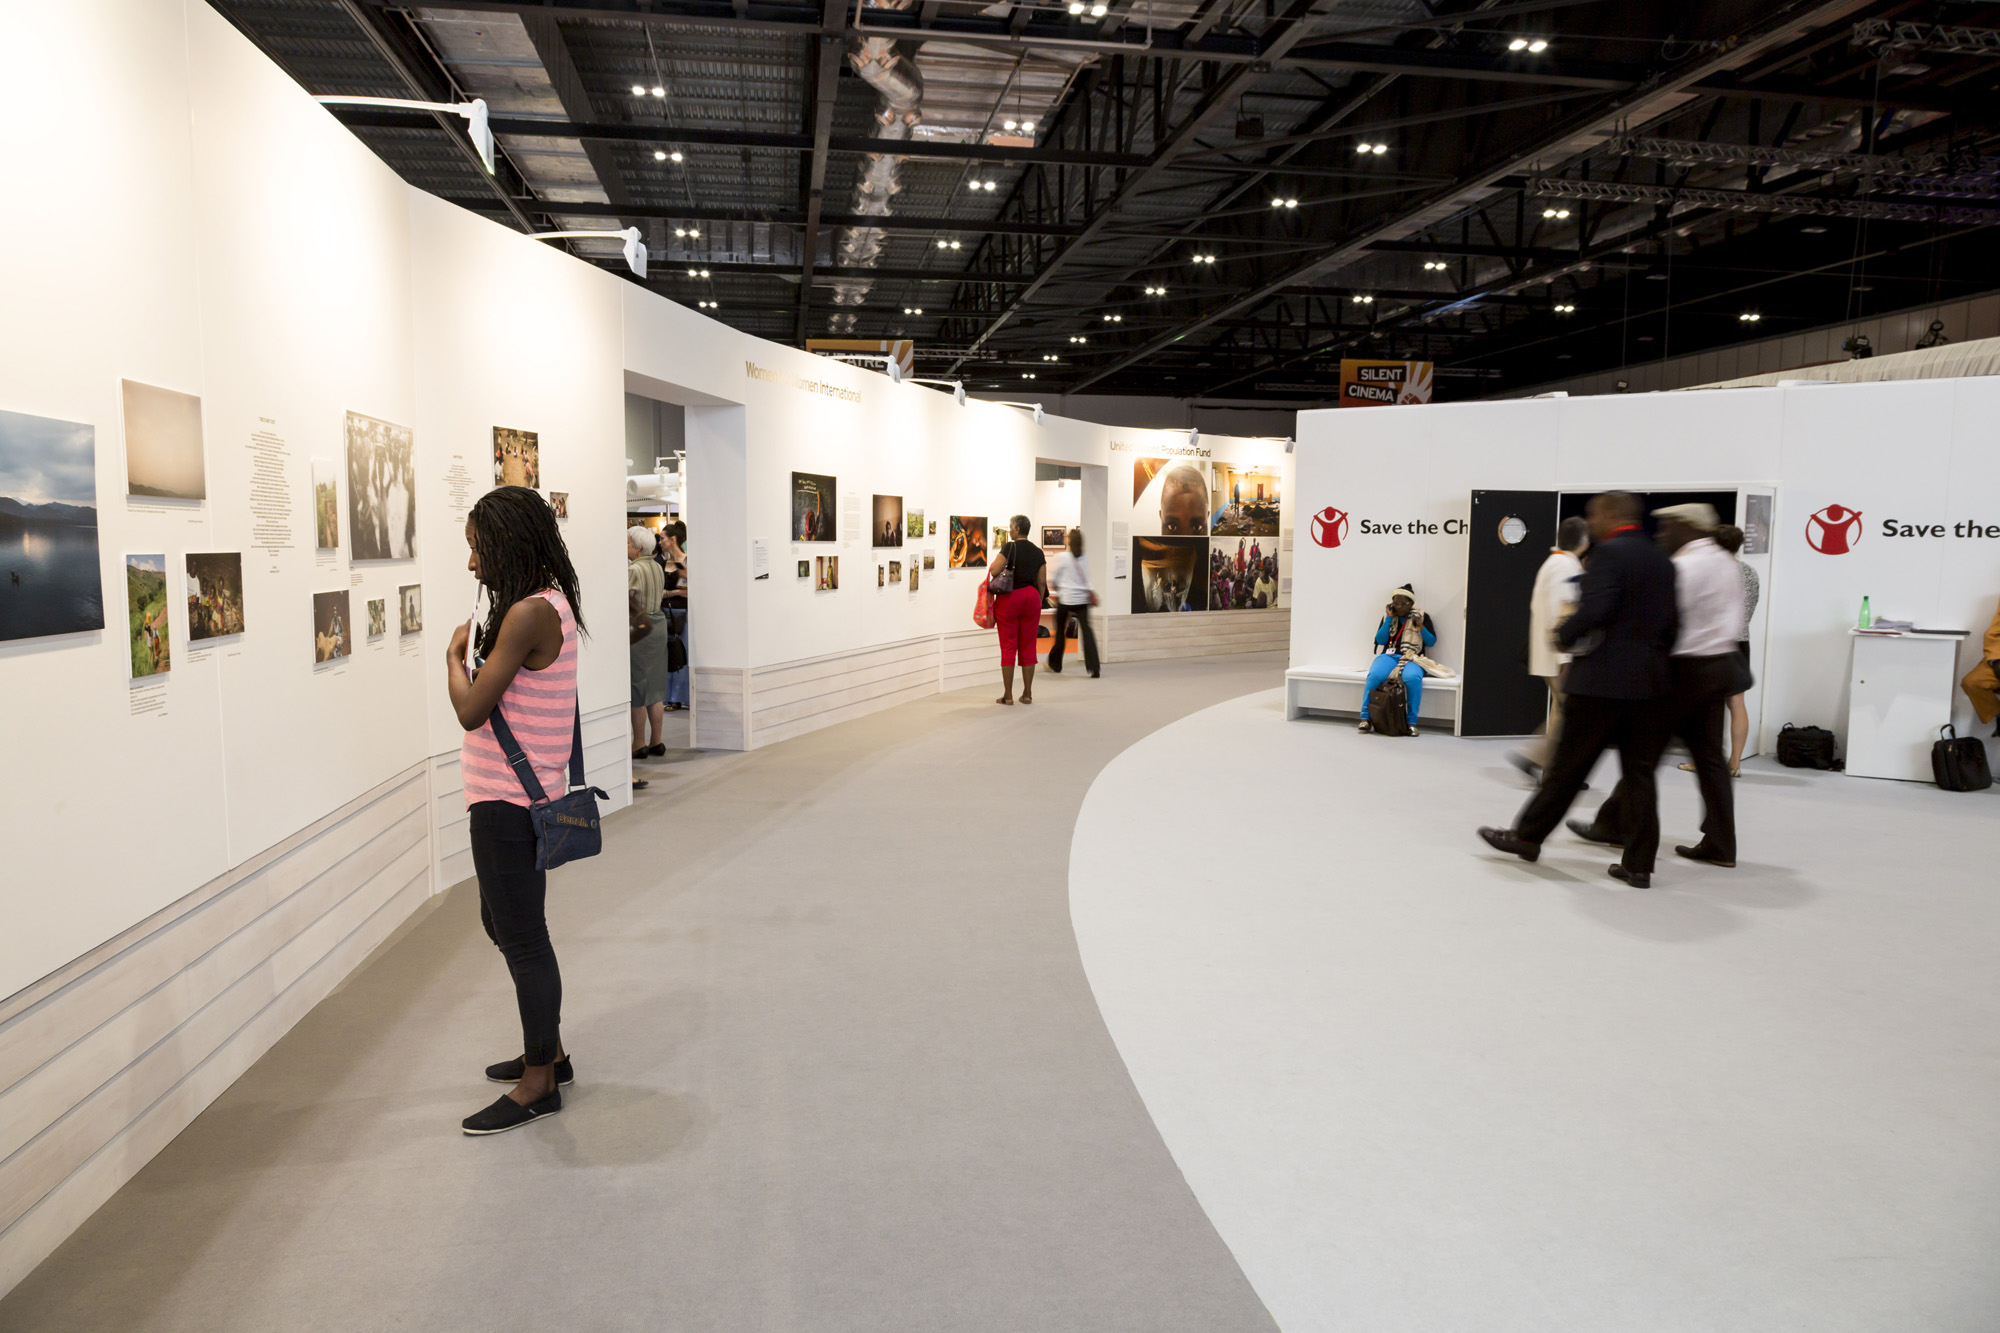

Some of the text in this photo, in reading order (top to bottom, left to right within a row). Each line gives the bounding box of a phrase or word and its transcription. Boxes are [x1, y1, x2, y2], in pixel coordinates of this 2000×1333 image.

[815, 351, 885, 368] ATRE
[745, 360, 778, 384] Women
[792, 372, 819, 393] Women
[819, 379, 862, 404] International
[1361, 368, 1402, 380] SILENT
[1348, 385, 1394, 402] CINEMA
[1161, 445, 1194, 457] Population
[1195, 447, 1211, 458] Fund
[1360, 519, 1402, 535] Save
[1408, 519, 1438, 535] the
[1882, 519, 2000, 538] Save the
